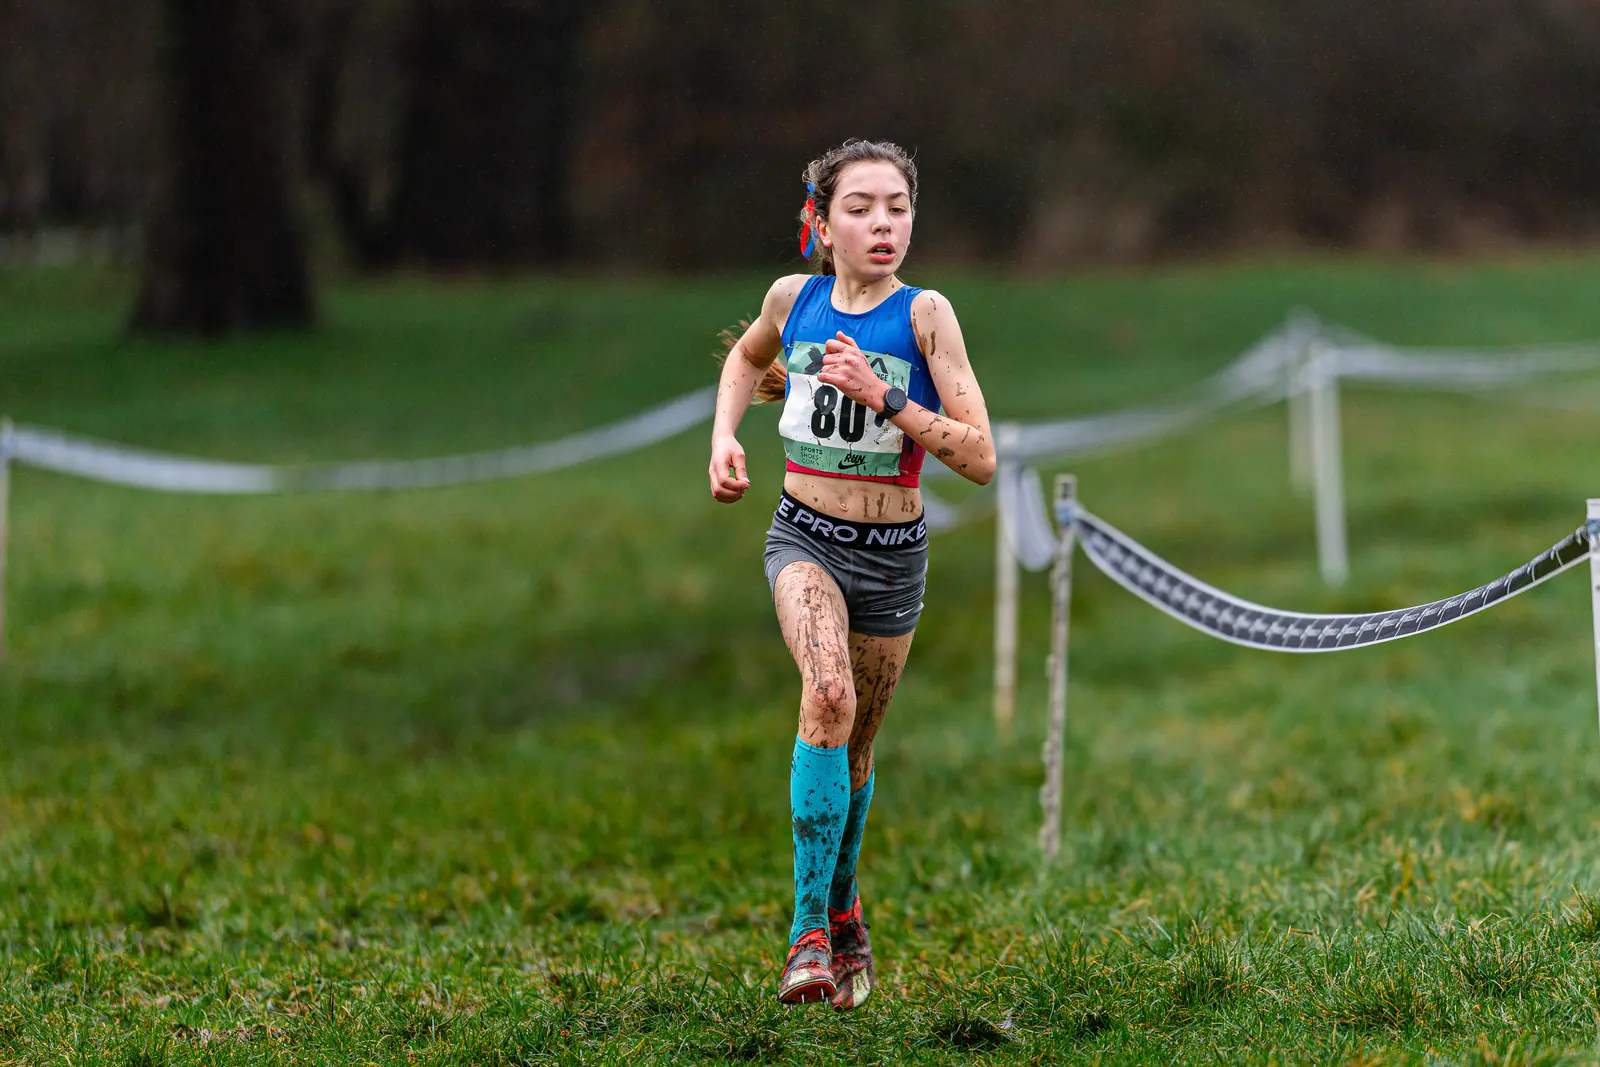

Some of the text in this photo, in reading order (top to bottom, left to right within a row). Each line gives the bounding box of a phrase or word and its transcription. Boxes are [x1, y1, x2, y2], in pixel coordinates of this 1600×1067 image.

[800, 446, 823, 455] SPORTS
[843, 453, 866, 464] RUN
[777, 495, 926, 546] E PRO NIKE
